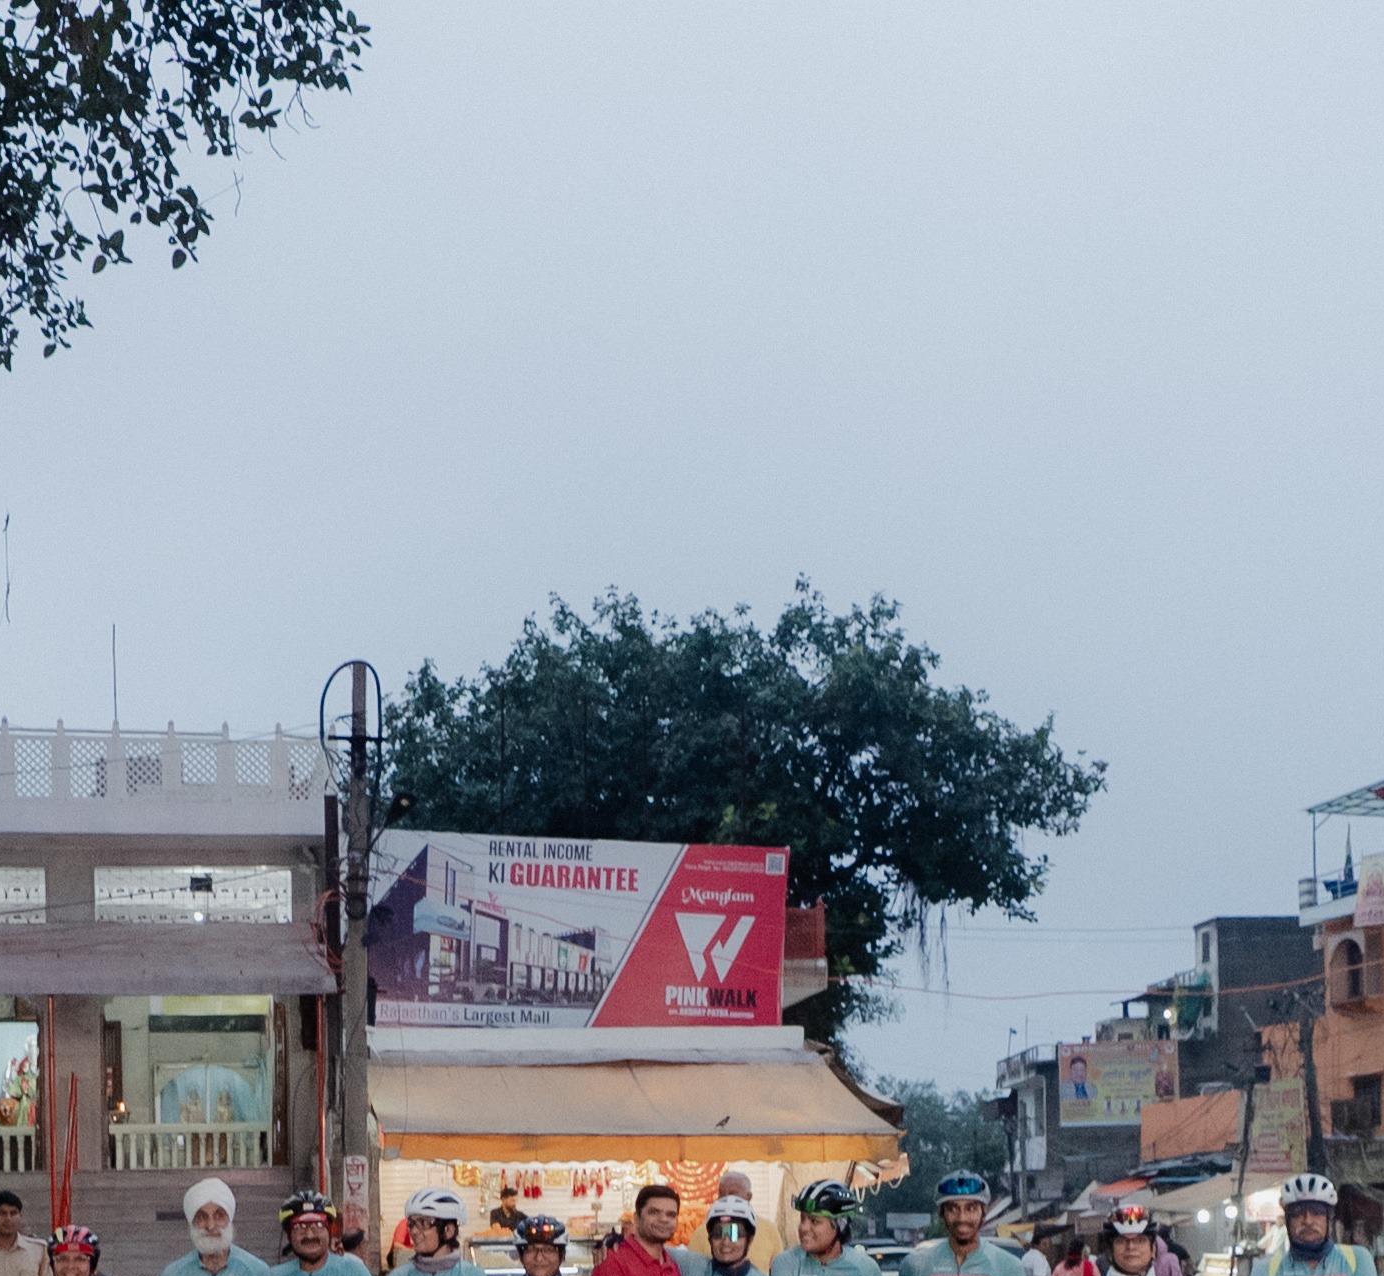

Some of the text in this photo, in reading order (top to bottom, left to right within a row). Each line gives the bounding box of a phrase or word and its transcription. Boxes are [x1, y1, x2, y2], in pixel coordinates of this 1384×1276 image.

[489, 840, 593, 861] RENTAL INCOME
[489, 862, 639, 892] KI GUARANTEE
[681, 887, 755, 907] Manglam
[380, 1004, 550, 1025] Rajasthan's Largest Mall
